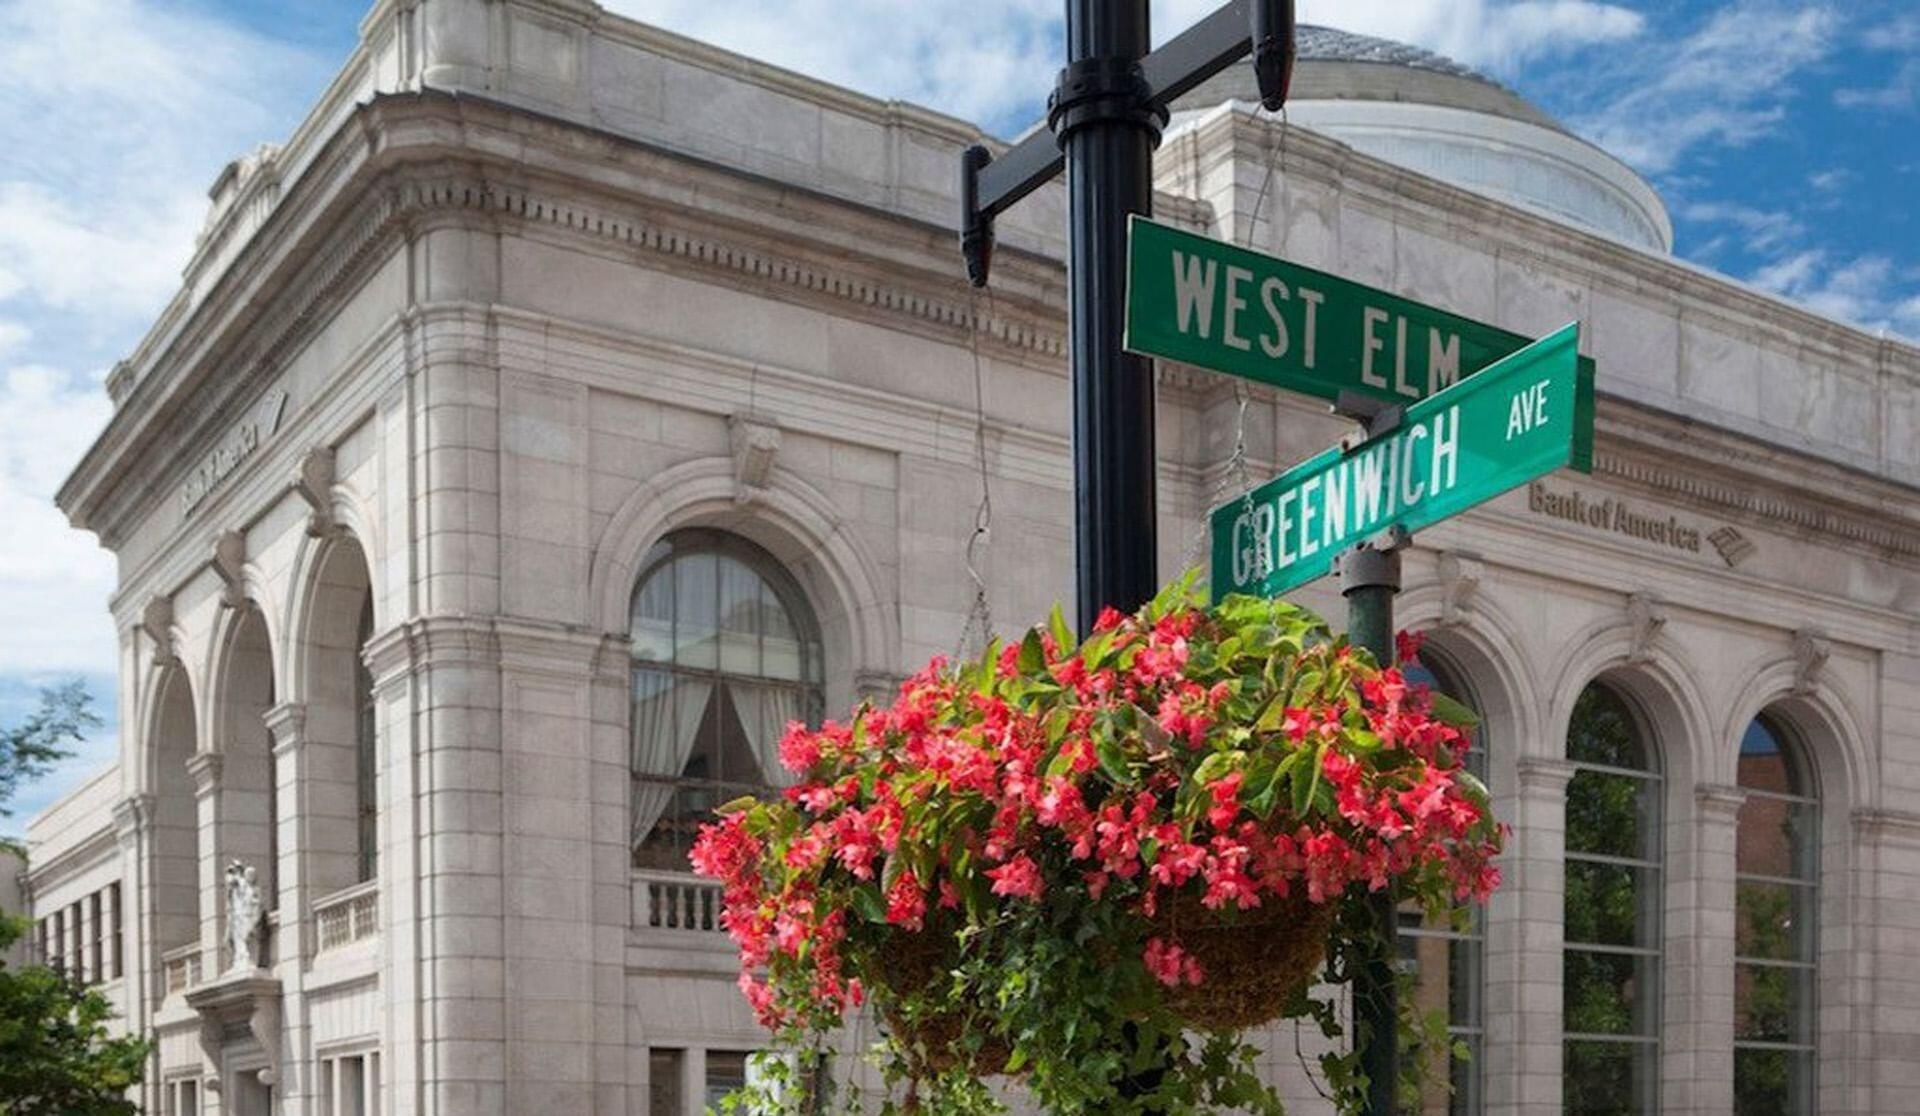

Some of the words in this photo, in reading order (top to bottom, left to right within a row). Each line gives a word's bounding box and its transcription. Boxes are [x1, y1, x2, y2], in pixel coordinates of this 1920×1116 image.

[1172, 250, 1325, 369] WEST
[1361, 306, 1461, 399] ELM
[1231, 404, 1461, 588] GREENWICH
[1507, 380, 1550, 441] AVE
[1529, 482, 1588, 524] Bank
[1590, 499, 1613, 530] of
[1614, 502, 1700, 552] America
